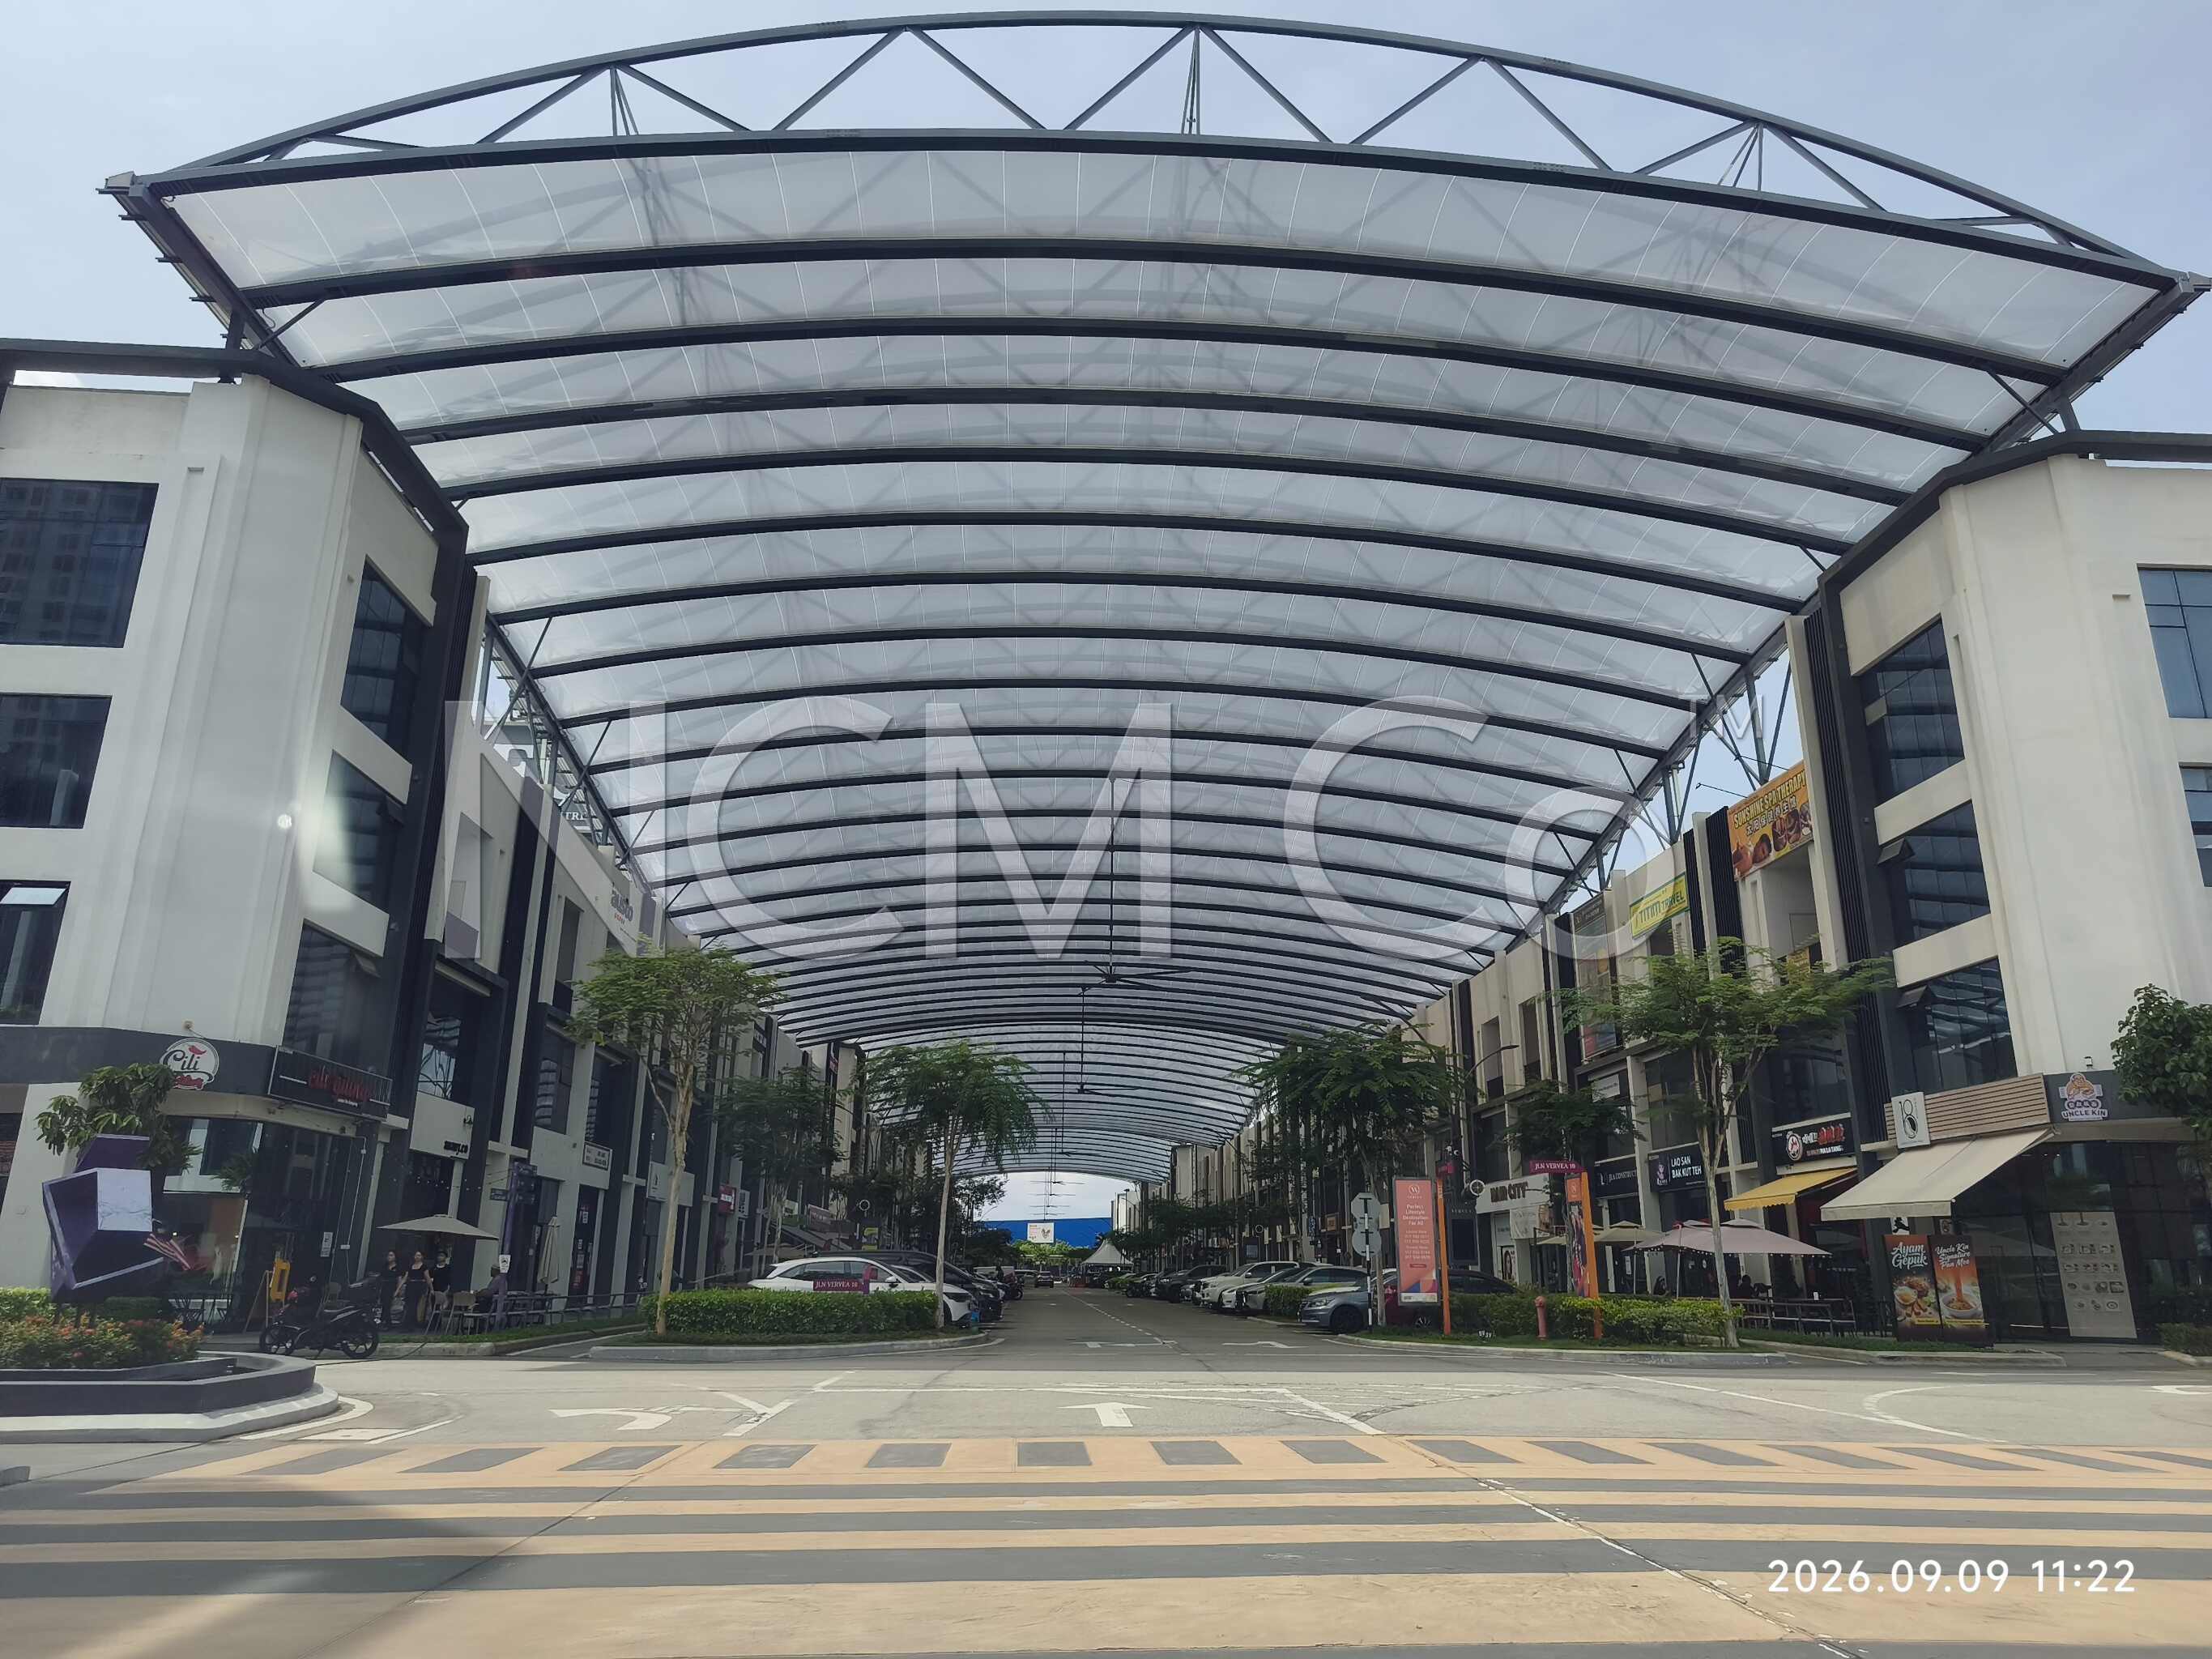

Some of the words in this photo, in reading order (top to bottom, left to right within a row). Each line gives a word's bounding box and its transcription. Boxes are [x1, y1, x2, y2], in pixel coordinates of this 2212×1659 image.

[1734, 799, 1763, 828] SUNSHINE
[1764, 790, 1777, 810] SPA
[1777, 770, 1806, 802] THERAPY
[1661, 890, 1685, 911] TRAVEL
[2063, 1110, 2089, 1118] UNCLE
[1671, 1157, 1681, 1167] LAO
[1681, 1155, 1691, 1166] SAN
[1672, 1168, 1681, 1179] BAK
[1682, 1167, 1692, 1177] KUT
[1692, 1166, 1702, 1175] TEH
[1891, 1242, 1925, 1258] Ayam
[1935, 1247, 1954, 1255] Uncle
[1955, 1243, 1969, 1252] Kin
[1891, 1253, 1928, 1269] Gepuk
[1938, 1252, 1971, 1262] Signature
[815, 1281, 825, 1290] JLN
